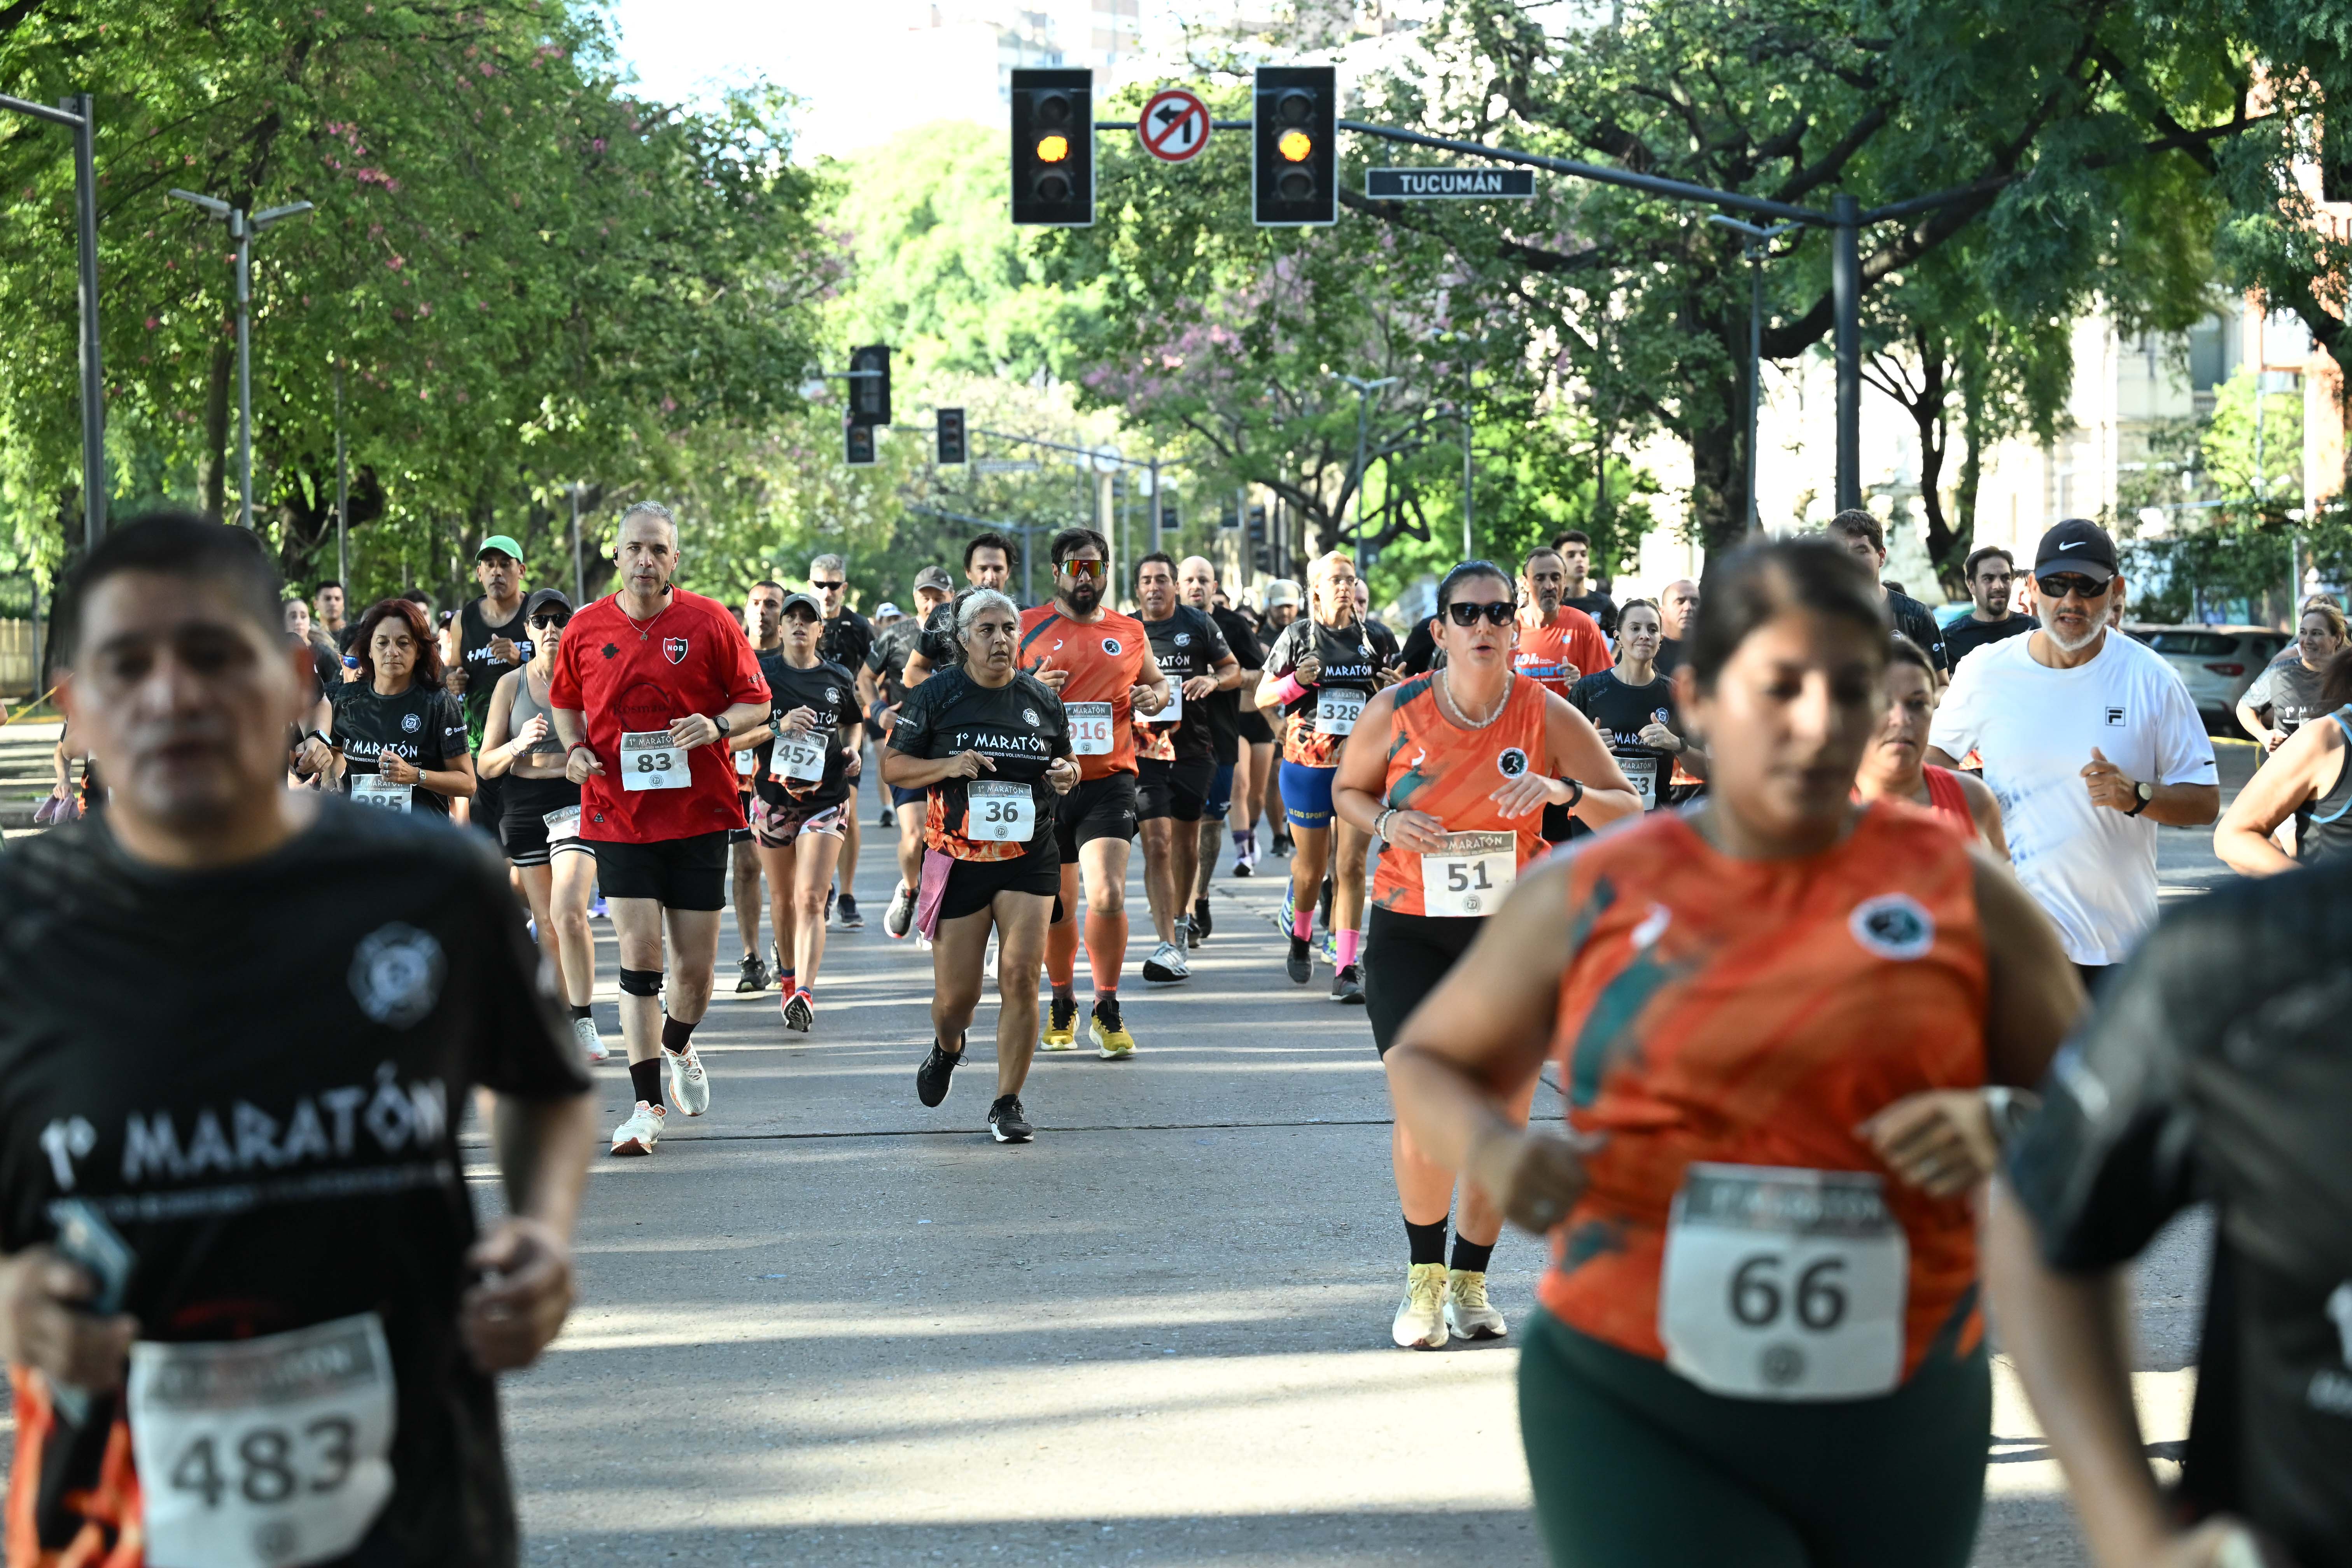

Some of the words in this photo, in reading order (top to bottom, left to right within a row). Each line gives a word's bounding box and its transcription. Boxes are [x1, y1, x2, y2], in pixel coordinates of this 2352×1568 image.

[1400, 170, 1502, 192] TUCUMÁN
[1154, 652, 1190, 666] RATÓN
[1325, 662, 1372, 677] MARATÓN
[1073, 705, 1105, 714] MARATÓN
[1323, 704, 1360, 721] 328
[956, 732, 969, 746] 1°
[975, 733, 1046, 752] MARATÓN
[638, 753, 672, 773] 83
[778, 744, 819, 766] 457
[1621, 761, 1651, 769] MARATÓN
[987, 785, 1024, 794] MARATÓN
[560, 807, 581, 819] MARAT
[985, 801, 1018, 822] 36
[1449, 835, 1502, 850] MARATÓN
[1448, 861, 1493, 892] 51
[121, 1059, 446, 1185] MARATÓN
[1729, 1253, 1845, 1334] 66
[170, 1414, 356, 1508] 483
